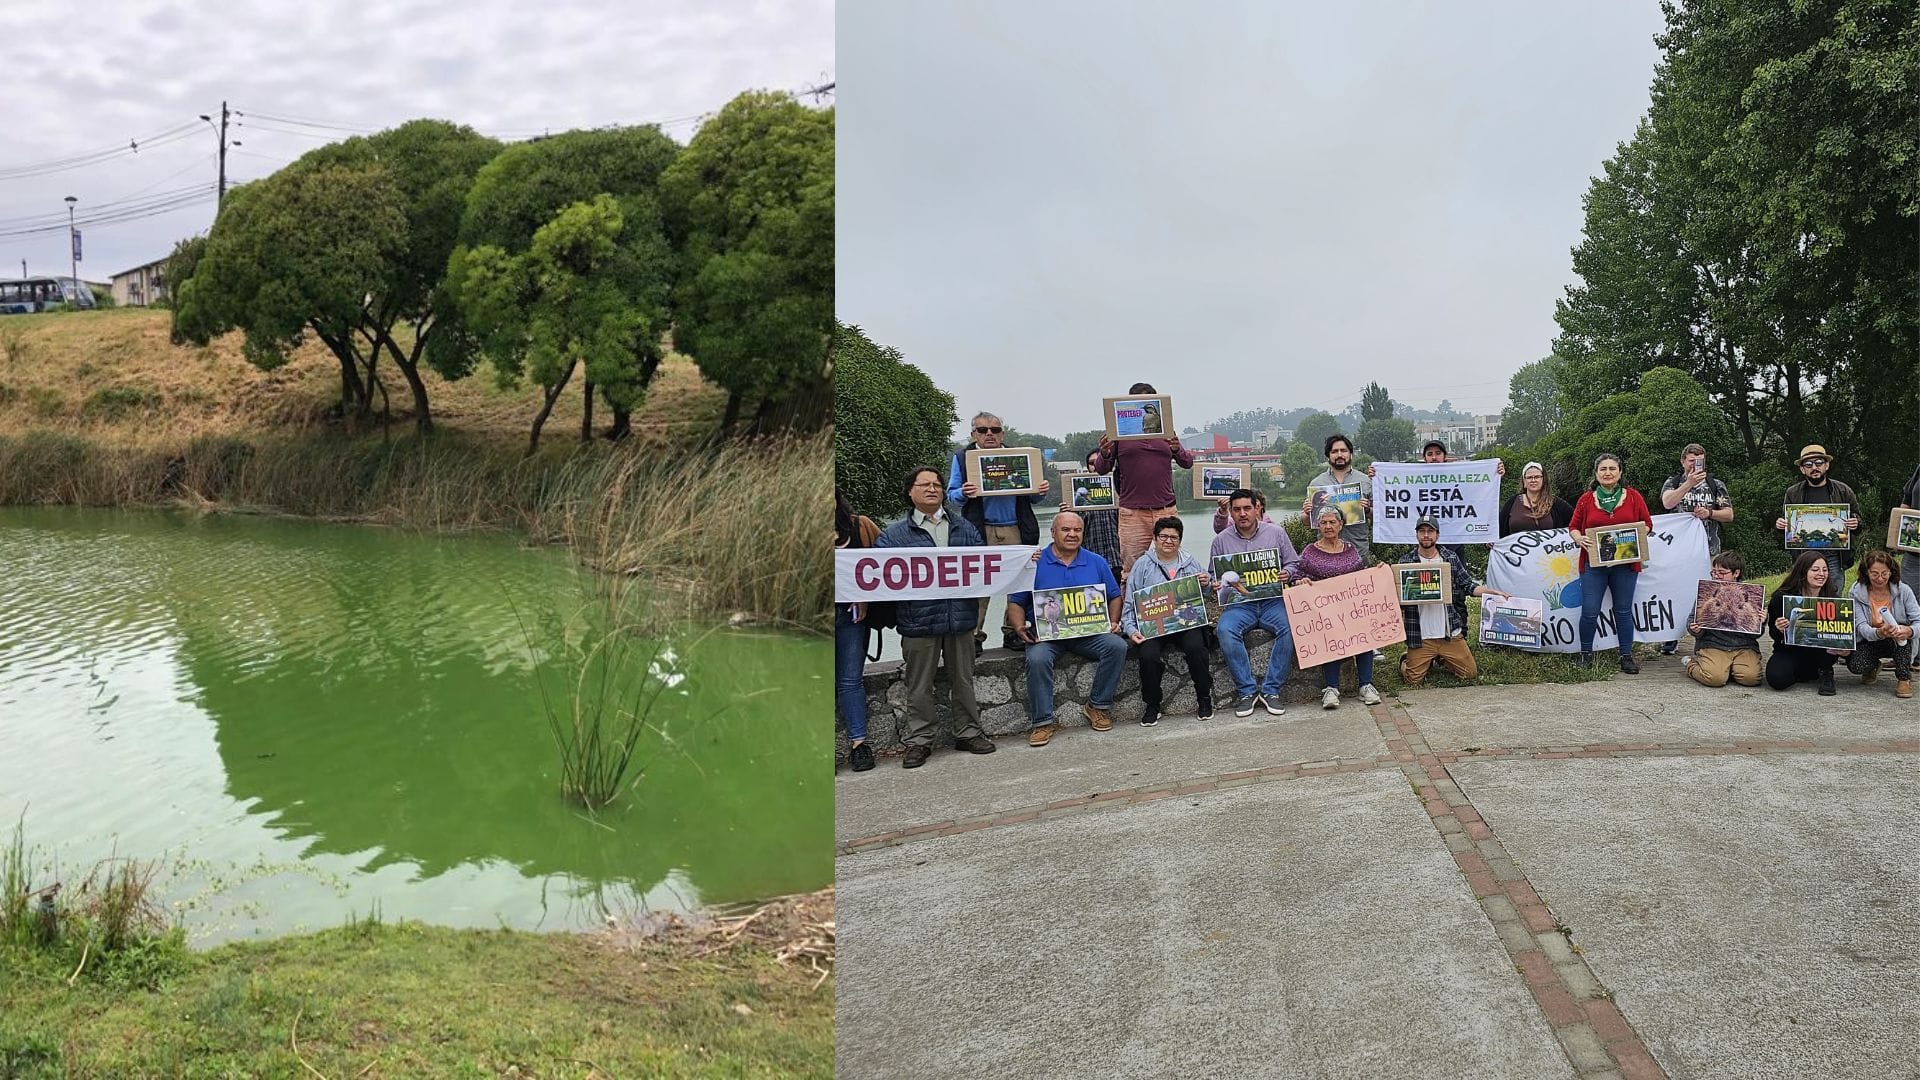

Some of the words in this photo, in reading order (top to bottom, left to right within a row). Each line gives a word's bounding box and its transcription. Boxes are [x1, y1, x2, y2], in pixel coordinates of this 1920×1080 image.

[1384, 476, 1400, 484] LA
[1406, 473, 1491, 484] NATURALEZA
[1090, 488, 1111, 498] TODXS
[1385, 490, 1411, 502] NO
[1419, 484, 1463, 502] ESTÁ
[1386, 506, 1408, 518] EN
[1416, 505, 1477, 518] VENTA
[1241, 554, 1250, 563] LA
[1251, 550, 1276, 562] LAGUNA
[854, 554, 1002, 591] CODEFF
[1244, 568, 1279, 586] TODXS
[1420, 571, 1430, 583] NO
[1063, 592, 1086, 615] NO
[1288, 595, 1311, 614] La
[1314, 575, 1375, 608] comunidad
[1144, 605, 1168, 616] TAGUA
[1296, 612, 1334, 636] cuida
[1350, 596, 1394, 620] defiende
[1816, 602, 1836, 620] NO
[1817, 620, 1853, 634] BASURA
[1300, 645, 1317, 658] su
[1324, 632, 1368, 656] laguna
